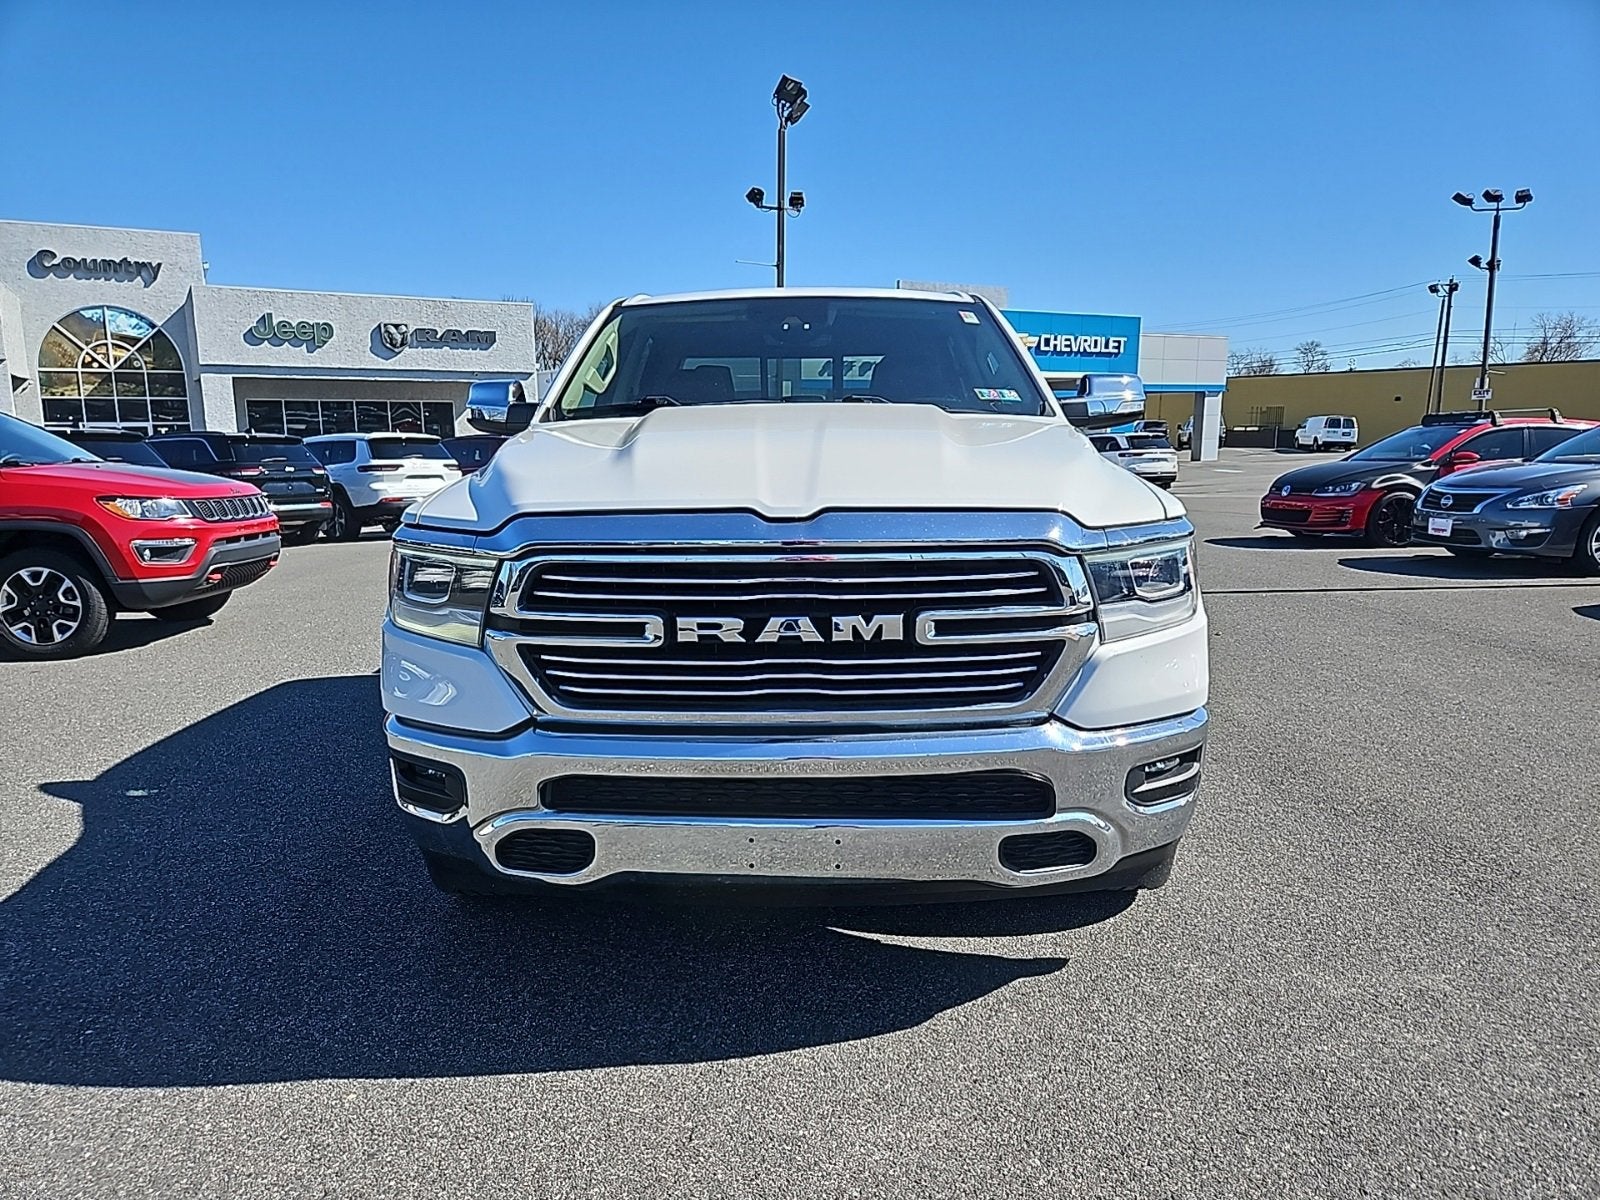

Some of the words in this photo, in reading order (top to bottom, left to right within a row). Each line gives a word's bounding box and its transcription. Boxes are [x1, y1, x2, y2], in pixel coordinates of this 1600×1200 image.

[34, 249, 162, 285] Country
[251, 312, 334, 347] Jeep
[414, 328, 496, 344] RAM
[1040, 334, 1127, 353] CHEVROLET
[676, 613, 904, 642] RAM
